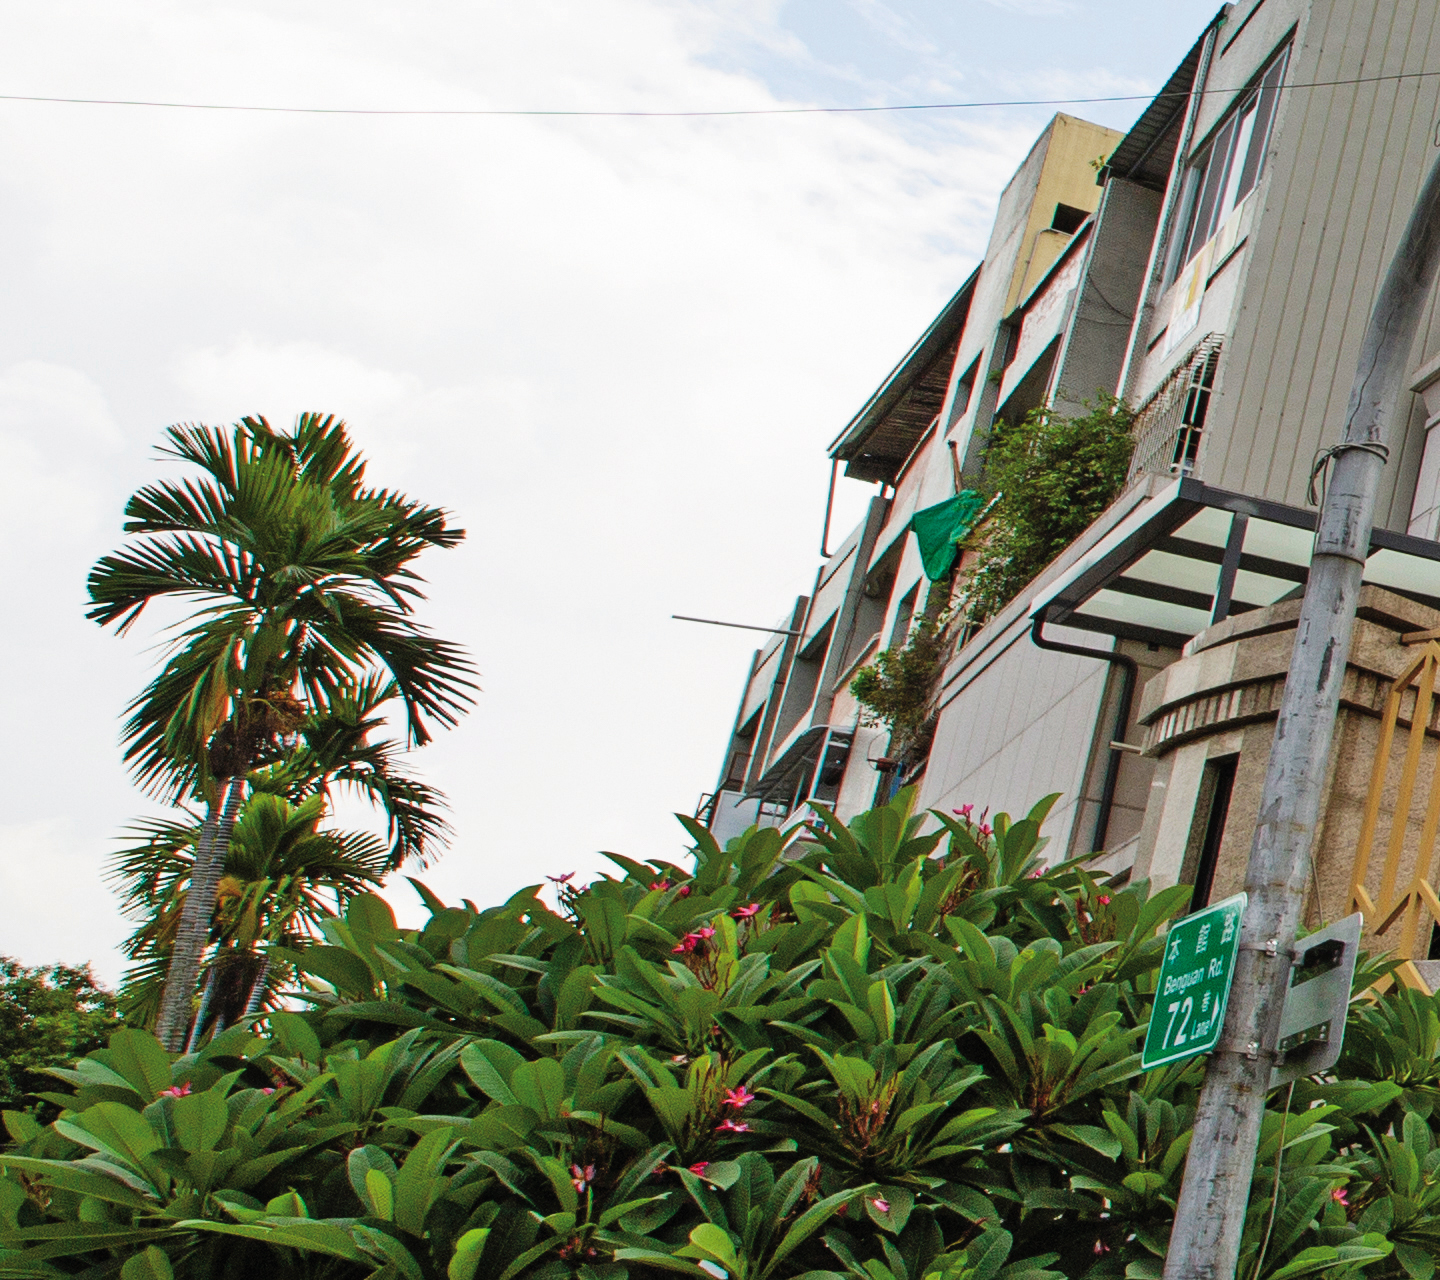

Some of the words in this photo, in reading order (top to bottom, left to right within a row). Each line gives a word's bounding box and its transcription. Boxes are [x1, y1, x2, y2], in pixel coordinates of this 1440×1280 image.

[1163, 967, 1205, 996] Benguan
[1208, 954, 1224, 979] Rd.
[1162, 996, 1194, 1050] 72
[1190, 1020, 1211, 1040] Lane
